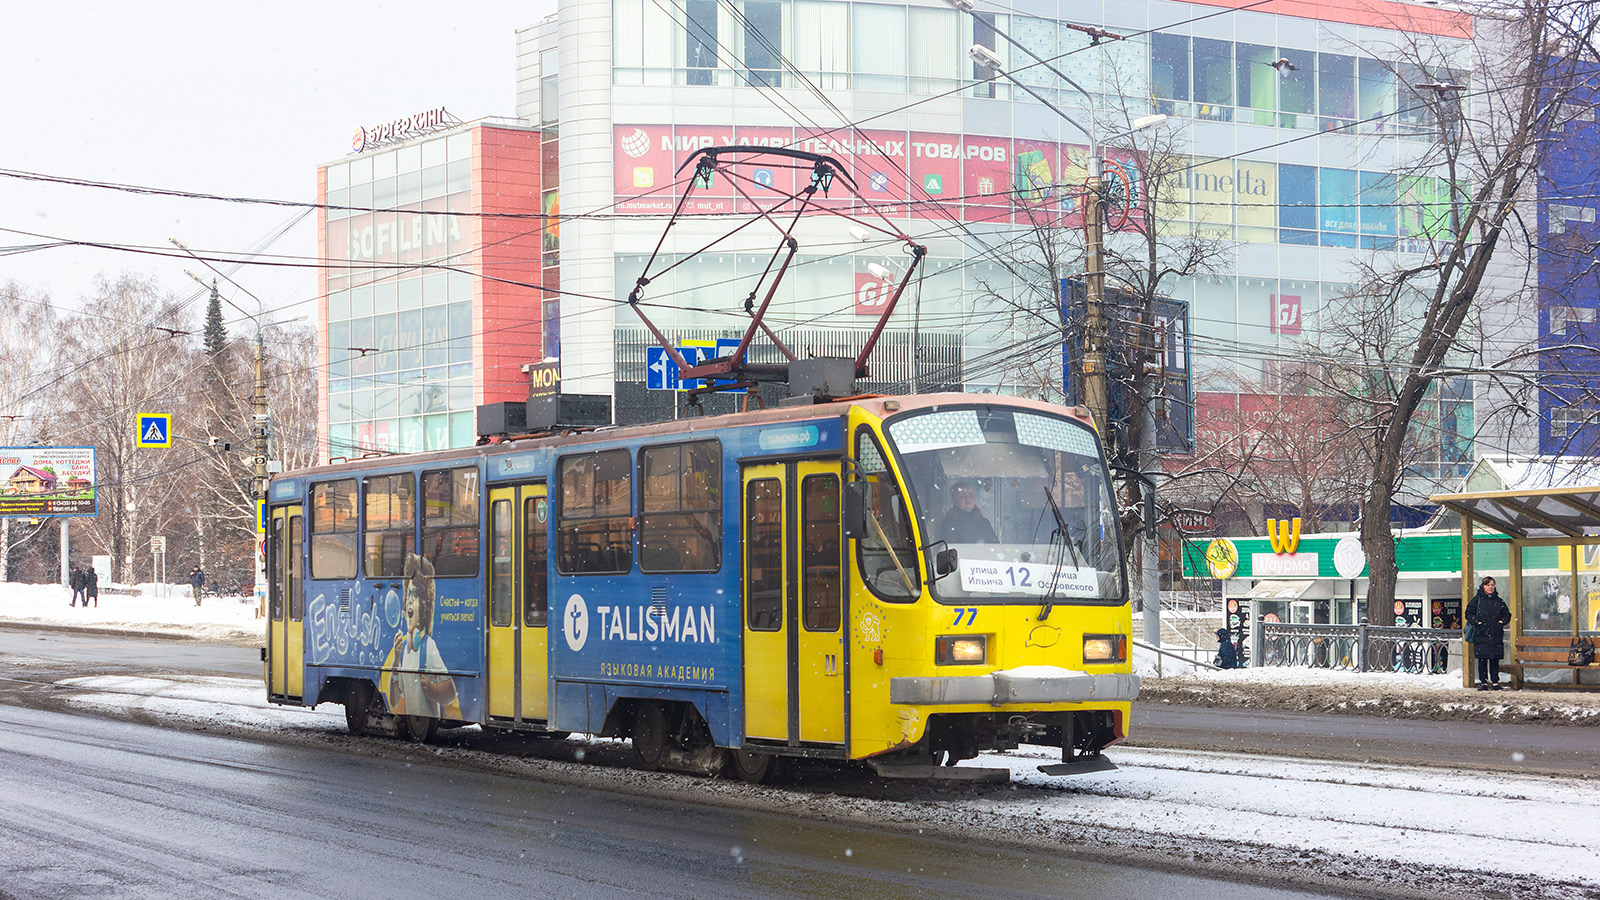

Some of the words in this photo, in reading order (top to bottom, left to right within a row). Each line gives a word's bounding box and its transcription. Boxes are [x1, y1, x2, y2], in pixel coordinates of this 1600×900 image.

[368, 118, 411, 142] БУРГЕР
[412, 107, 444, 130] КИНГ
[661, 135, 714, 151] МИР
[912, 142, 1006, 162] ТОВАРОВ
[347, 208, 461, 261] SOFILENA
[1325, 220, 1338, 228] ВСЕ
[1339, 221, 1352, 230] ДЛЯ
[1353, 222, 1387, 232] ПАВАНИЯ
[858, 282, 889, 306] GJ
[1279, 303, 1299, 326] GJ
[464, 473, 478, 501] 77
[968, 577, 1003, 586] Ильича
[970, 566, 998, 576] улица
[1005, 566, 1032, 587] 12
[597, 605, 715, 644] TALISMAN
[953, 607, 977, 626] 77
[601, 662, 652, 677] ЯЗЫКОВАЯ
[657, 664, 715, 681] АКАДЕМИЯ
